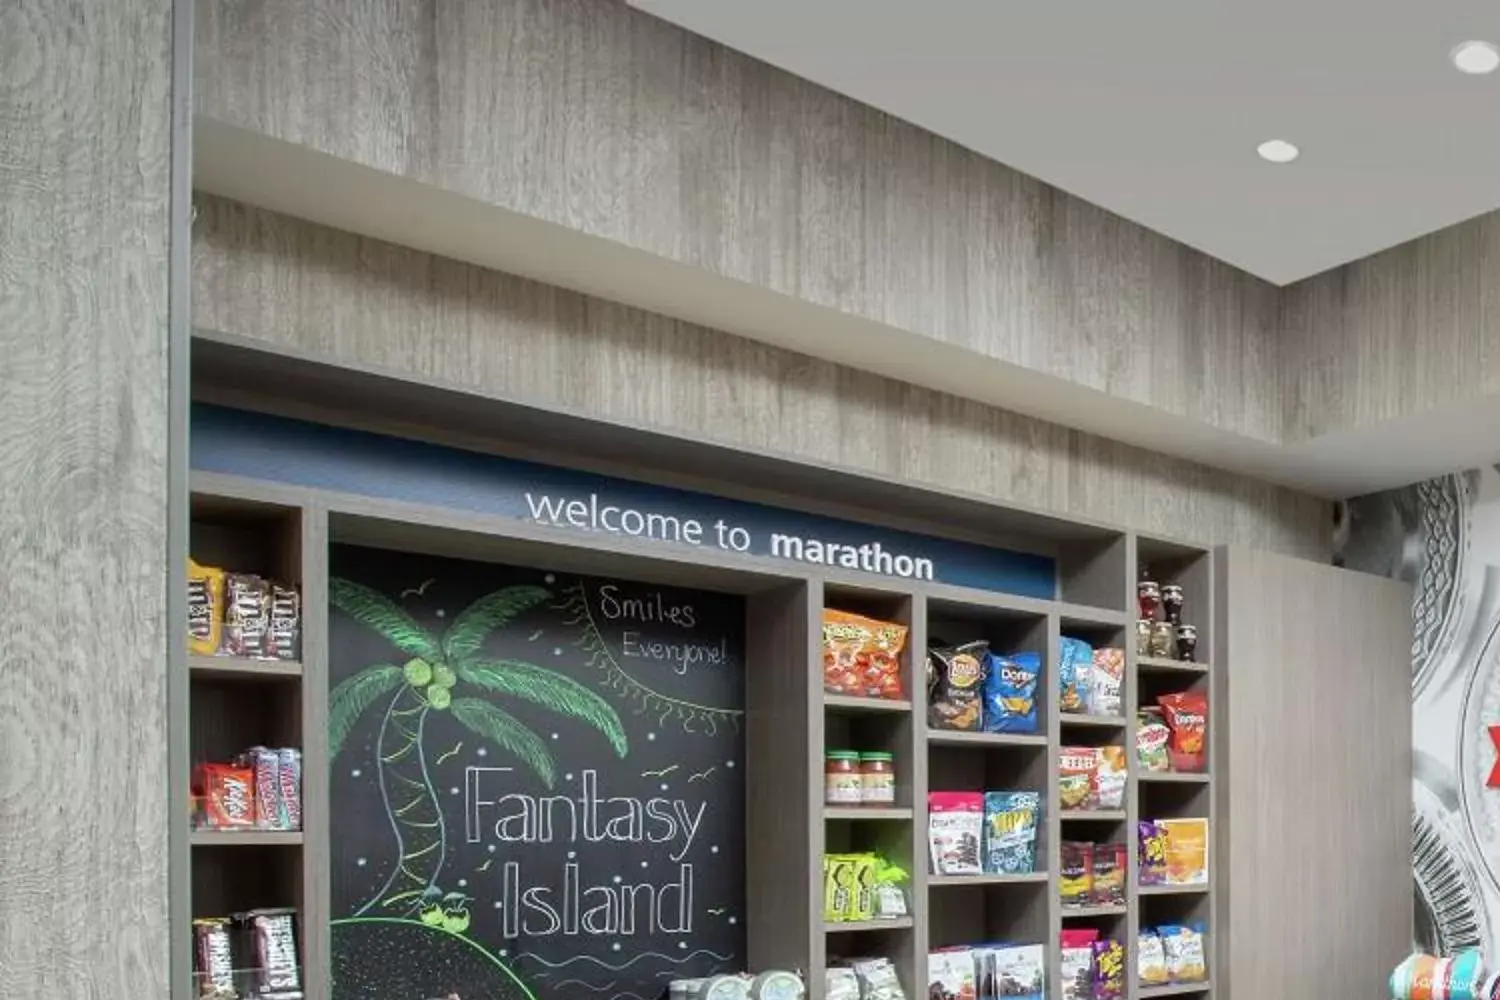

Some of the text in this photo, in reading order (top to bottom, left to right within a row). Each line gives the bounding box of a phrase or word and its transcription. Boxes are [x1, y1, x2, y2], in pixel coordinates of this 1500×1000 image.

[524, 491, 935, 581] welcome to marathon
[599, 584, 697, 629] Smiles
[621, 631, 729, 676] Everyone!
[465, 766, 708, 862] Fantasy
[503, 851, 694, 939] Island
